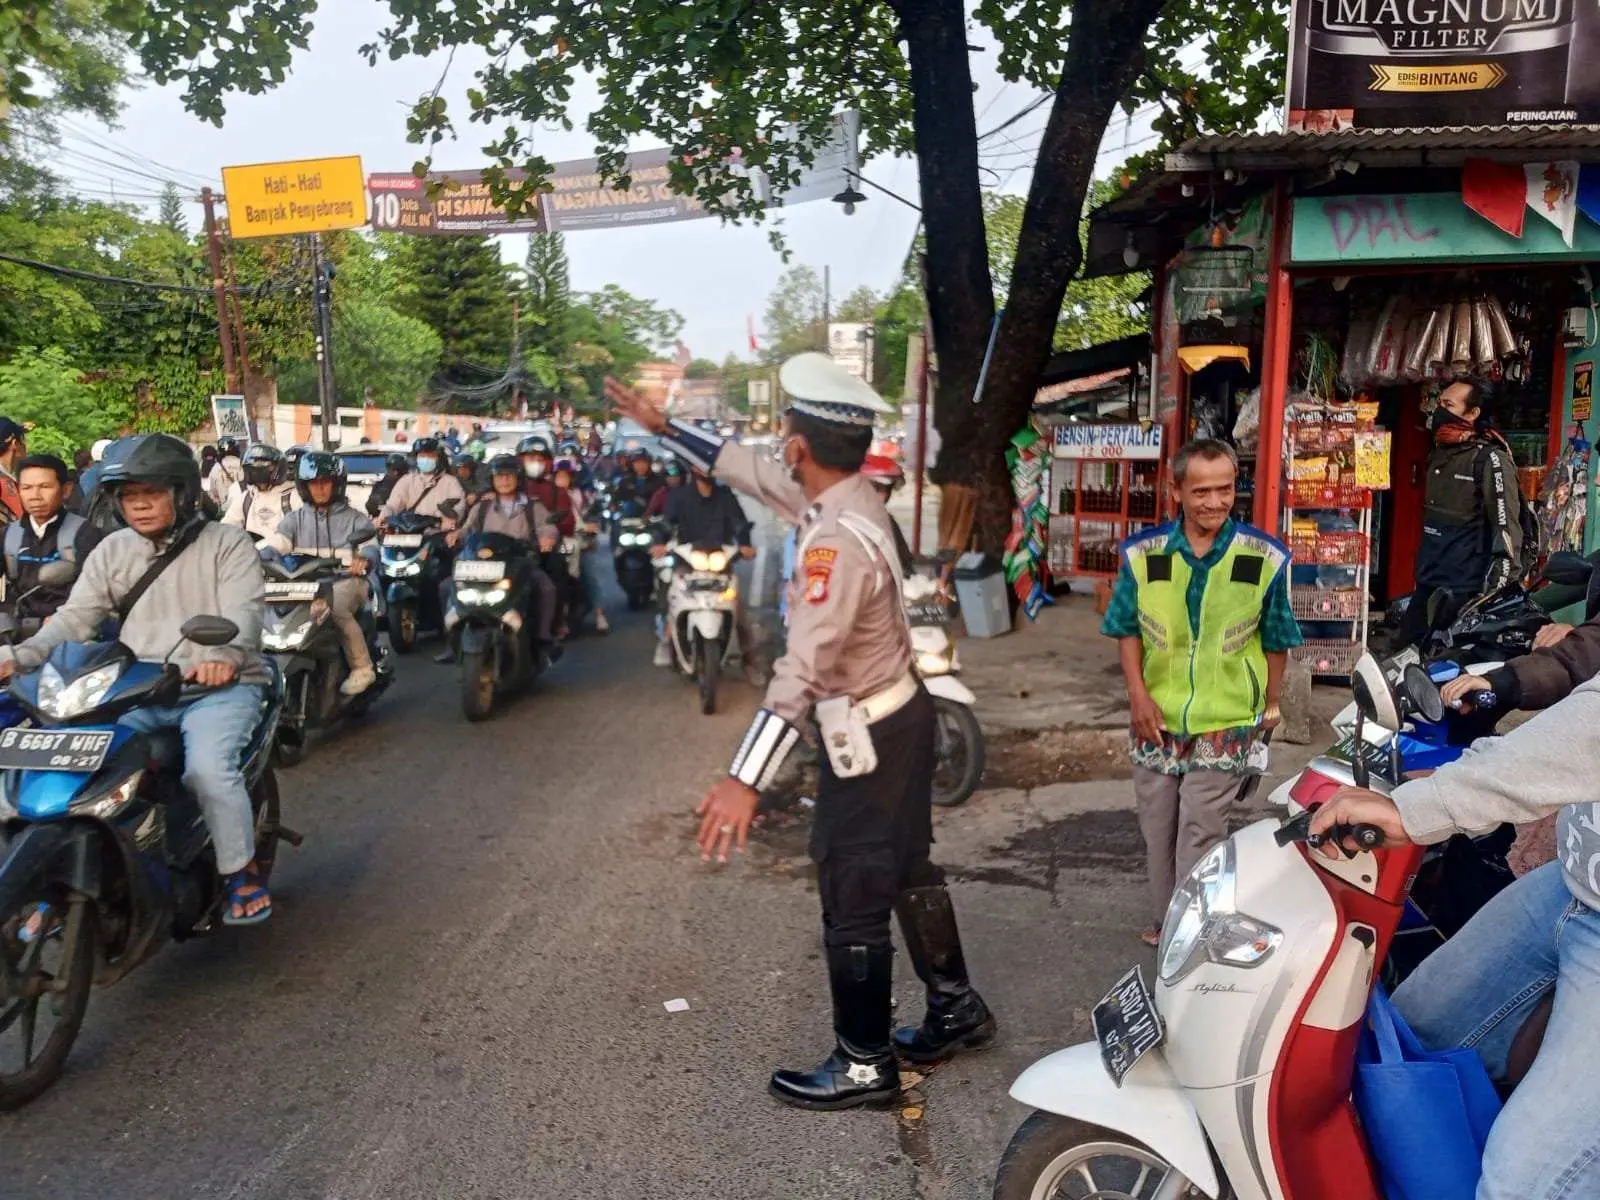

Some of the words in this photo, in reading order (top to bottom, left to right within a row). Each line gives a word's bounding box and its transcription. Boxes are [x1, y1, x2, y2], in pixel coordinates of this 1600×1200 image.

[1335, 0, 1548, 25] MAGNUM
[1393, 28, 1488, 48] FILTER
[1397, 72, 1419, 81] EDISI
[1420, 72, 1478, 86] BINTANG
[1506, 110, 1577, 121] PERINGATAN:
[263, 176, 288, 194] Hati
[297, 172, 322, 191] Hati
[245, 202, 287, 225] Banyak
[289, 200, 354, 221] Penyebrang
[374, 192, 399, 228] 10
[1118, 980, 1145, 1023] 6502
